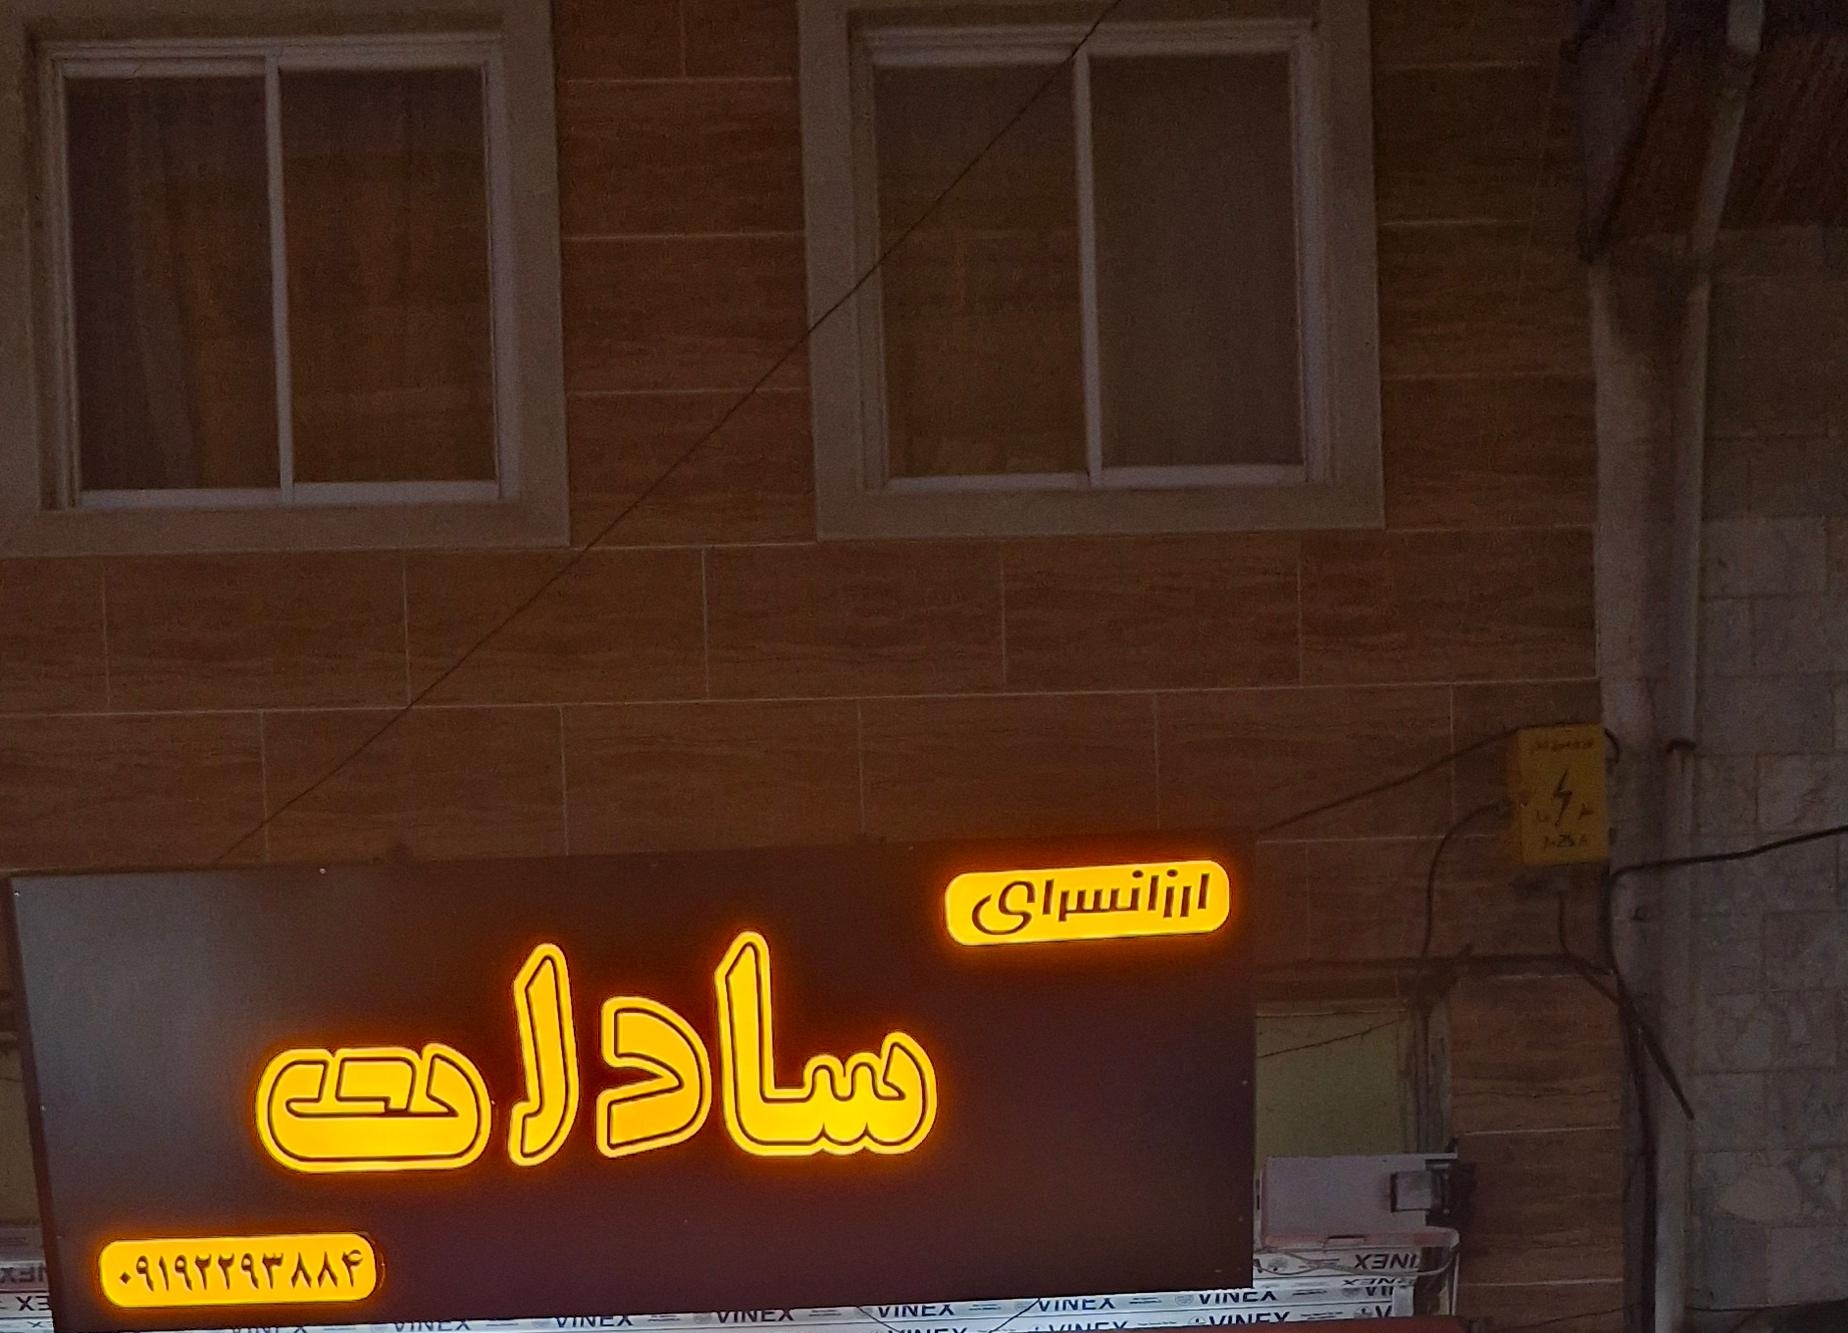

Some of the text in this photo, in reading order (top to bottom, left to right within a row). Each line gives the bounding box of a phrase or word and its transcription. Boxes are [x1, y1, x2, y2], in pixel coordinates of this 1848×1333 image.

[971, 869, 1210, 936] ارزانسرای
[256, 931, 937, 1172] سادات
[119, 1248, 364, 1294] ۰۹۱۹۲۲۹۳۸۸۴
